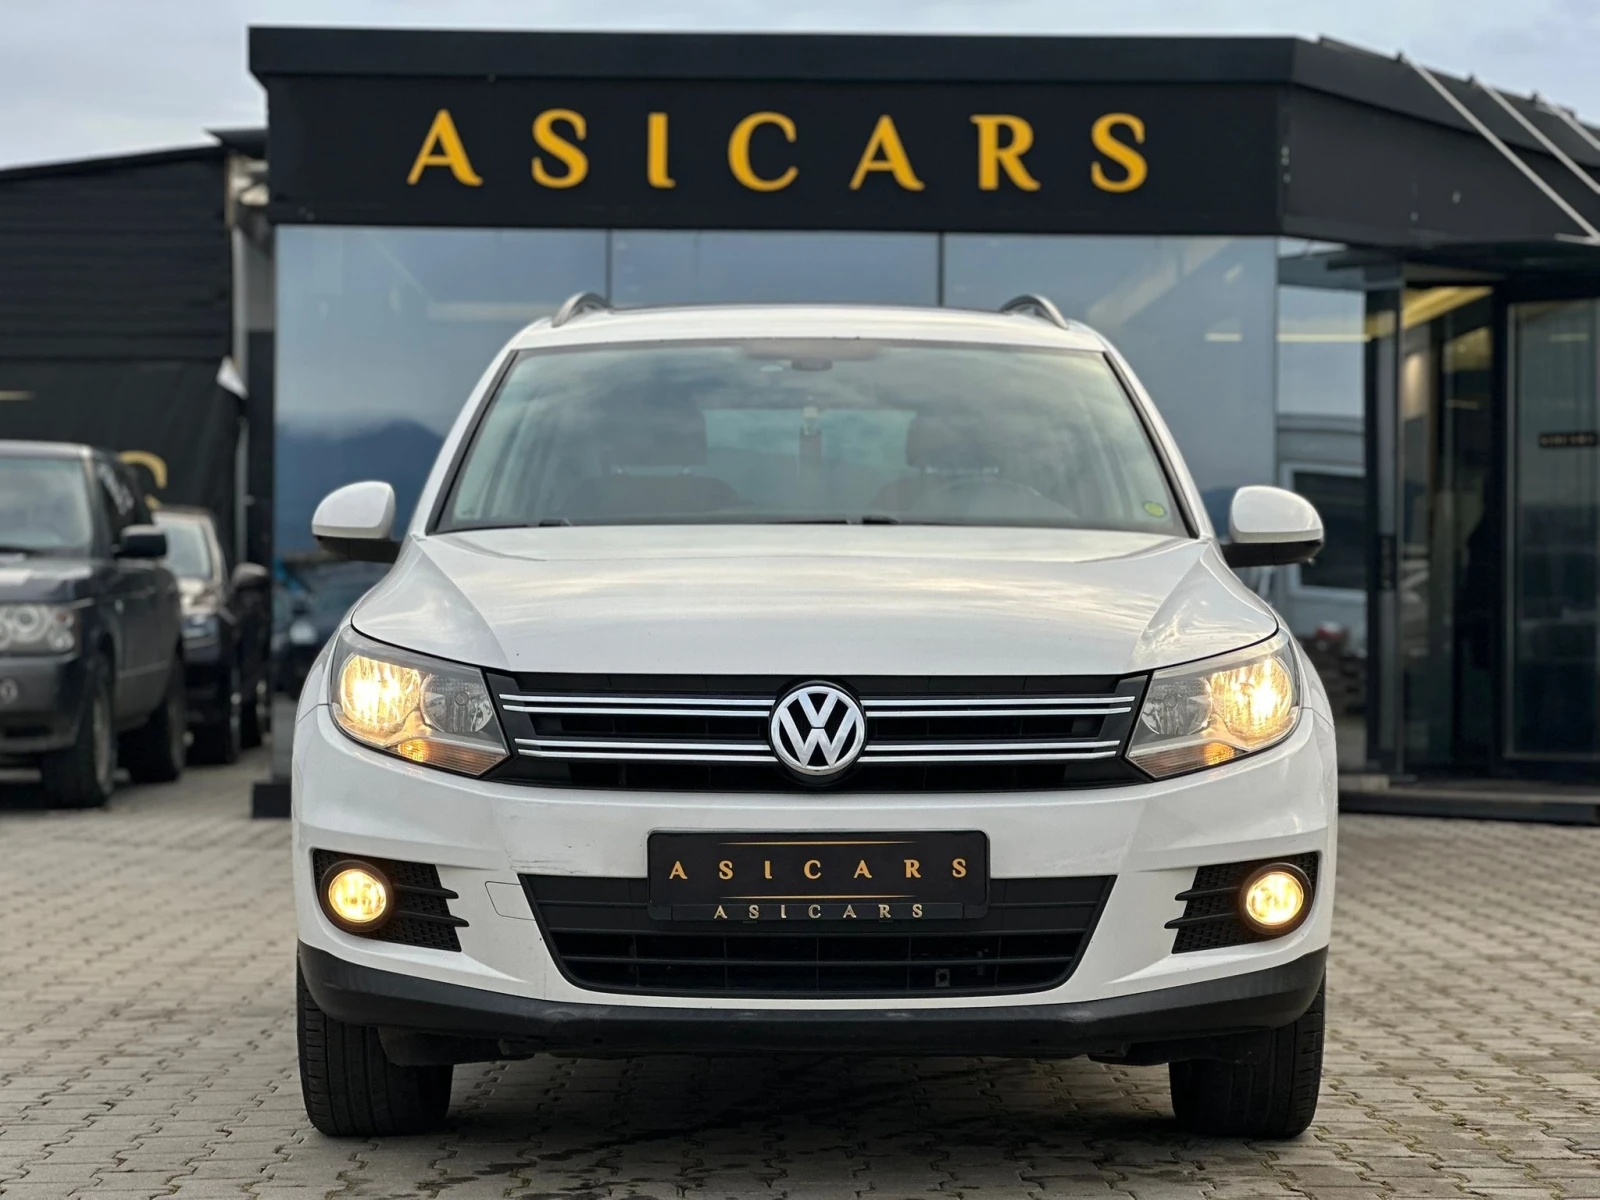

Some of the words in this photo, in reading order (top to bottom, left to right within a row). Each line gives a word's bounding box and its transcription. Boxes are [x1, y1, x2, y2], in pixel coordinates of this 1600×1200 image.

[408, 109, 1147, 192] ASICARS
[771, 686, 865, 775] VW
[669, 858, 967, 880] ASICARS
[713, 904, 924, 919] ASICARS
